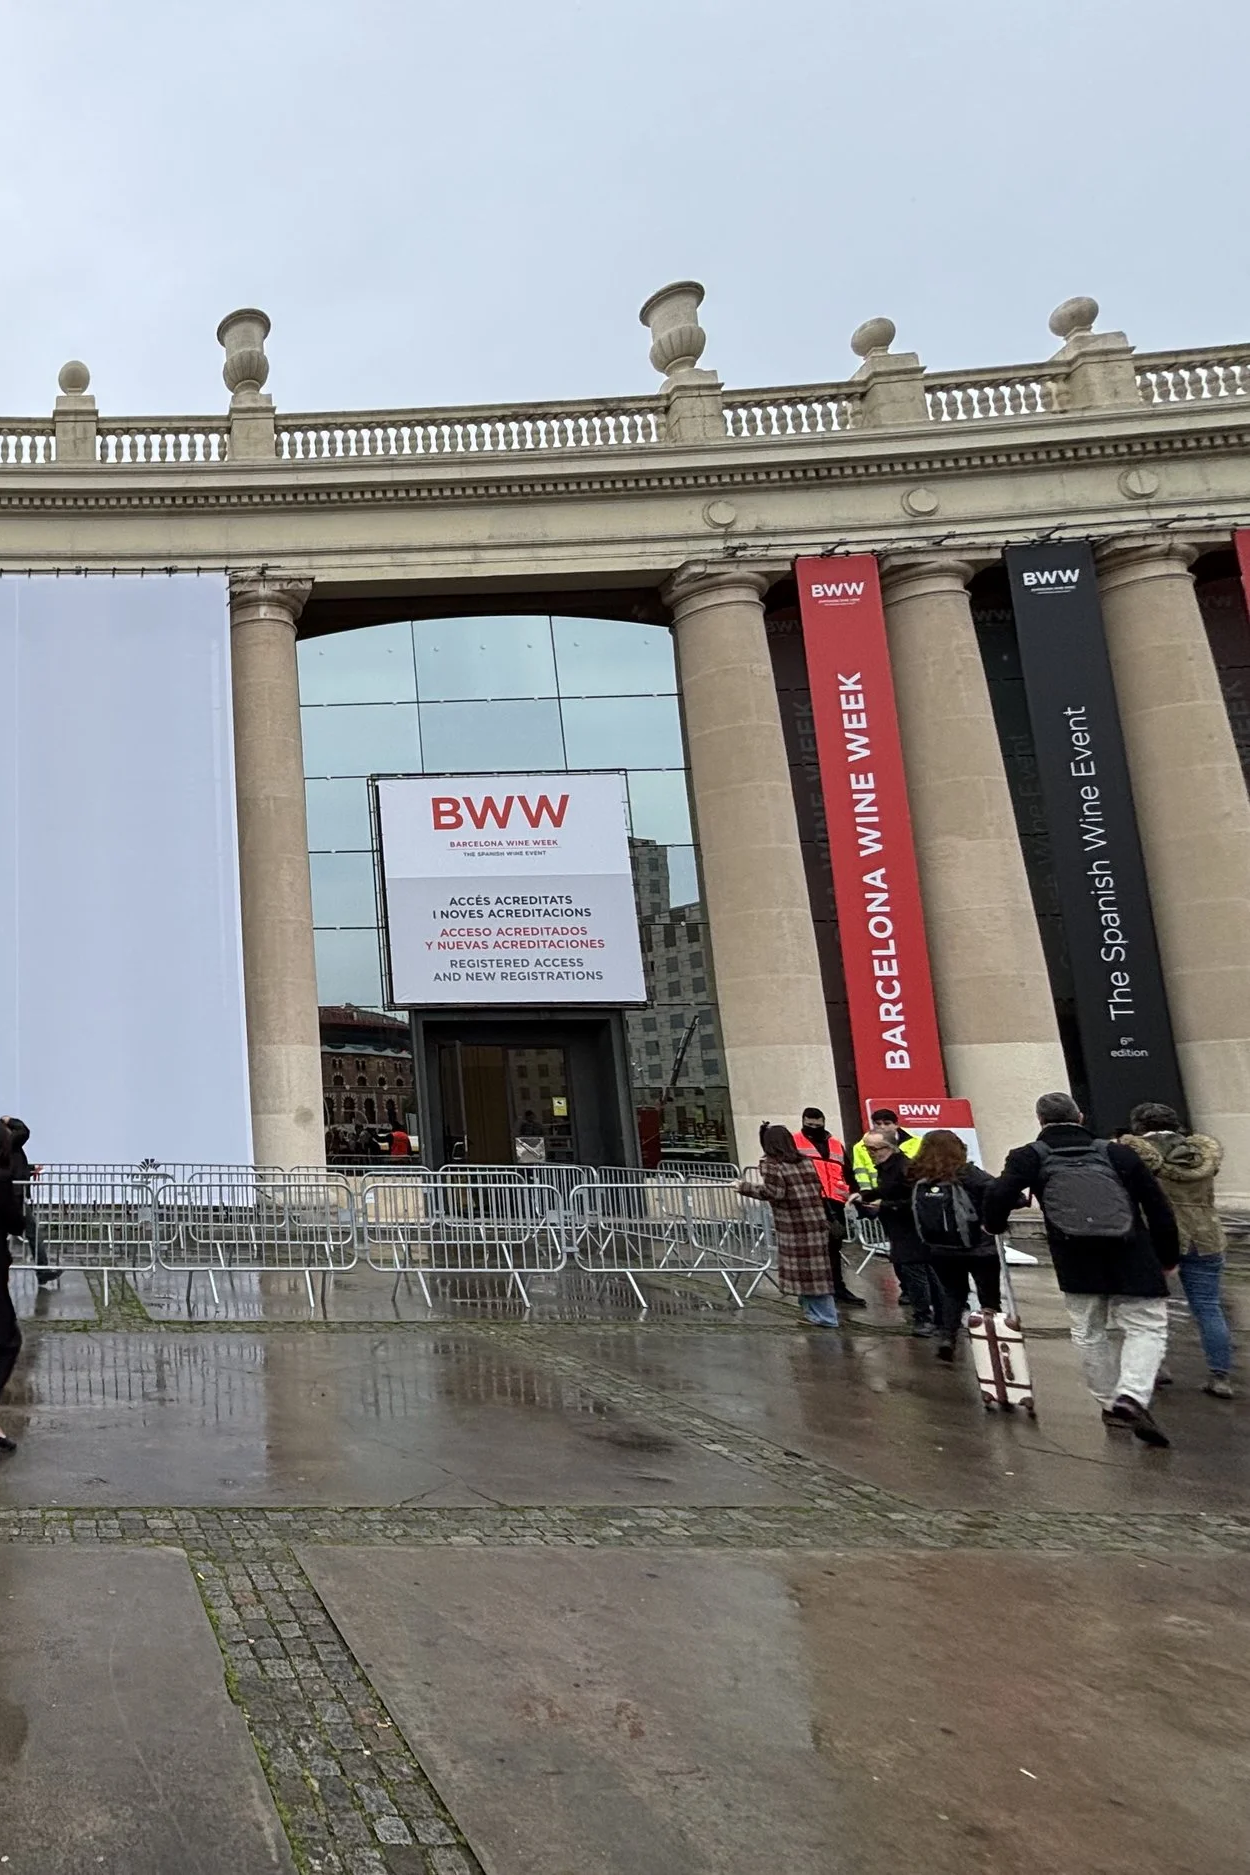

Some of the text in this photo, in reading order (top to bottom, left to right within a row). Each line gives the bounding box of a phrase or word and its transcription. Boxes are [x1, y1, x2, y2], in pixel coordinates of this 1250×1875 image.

[1022, 568, 1080, 586] BWW
[811, 581, 865, 598] BWW
[431, 794, 570, 830] BWW
[450, 840, 503, 848] BARCELONA
[1063, 706, 1134, 1020] The Spanish Wine Event
[838, 672, 910, 1069] BARCELONA WINE WEEK
[449, 894, 573, 906] ACCÉS ACREDITATS
[432, 908, 592, 919] I NOVES ACREDITACIONS
[440, 926, 588, 937] ACCESO ACREDITADOS
[425, 939, 605, 950] Y NUEVAS ACREDITACIONES
[450, 958, 584, 968] REGISTERED ACCESS
[433, 970, 603, 982] AND NEW REGISTRATIONS
[1110, 1048, 1149, 1057] edition
[898, 1104, 941, 1116] BWW
